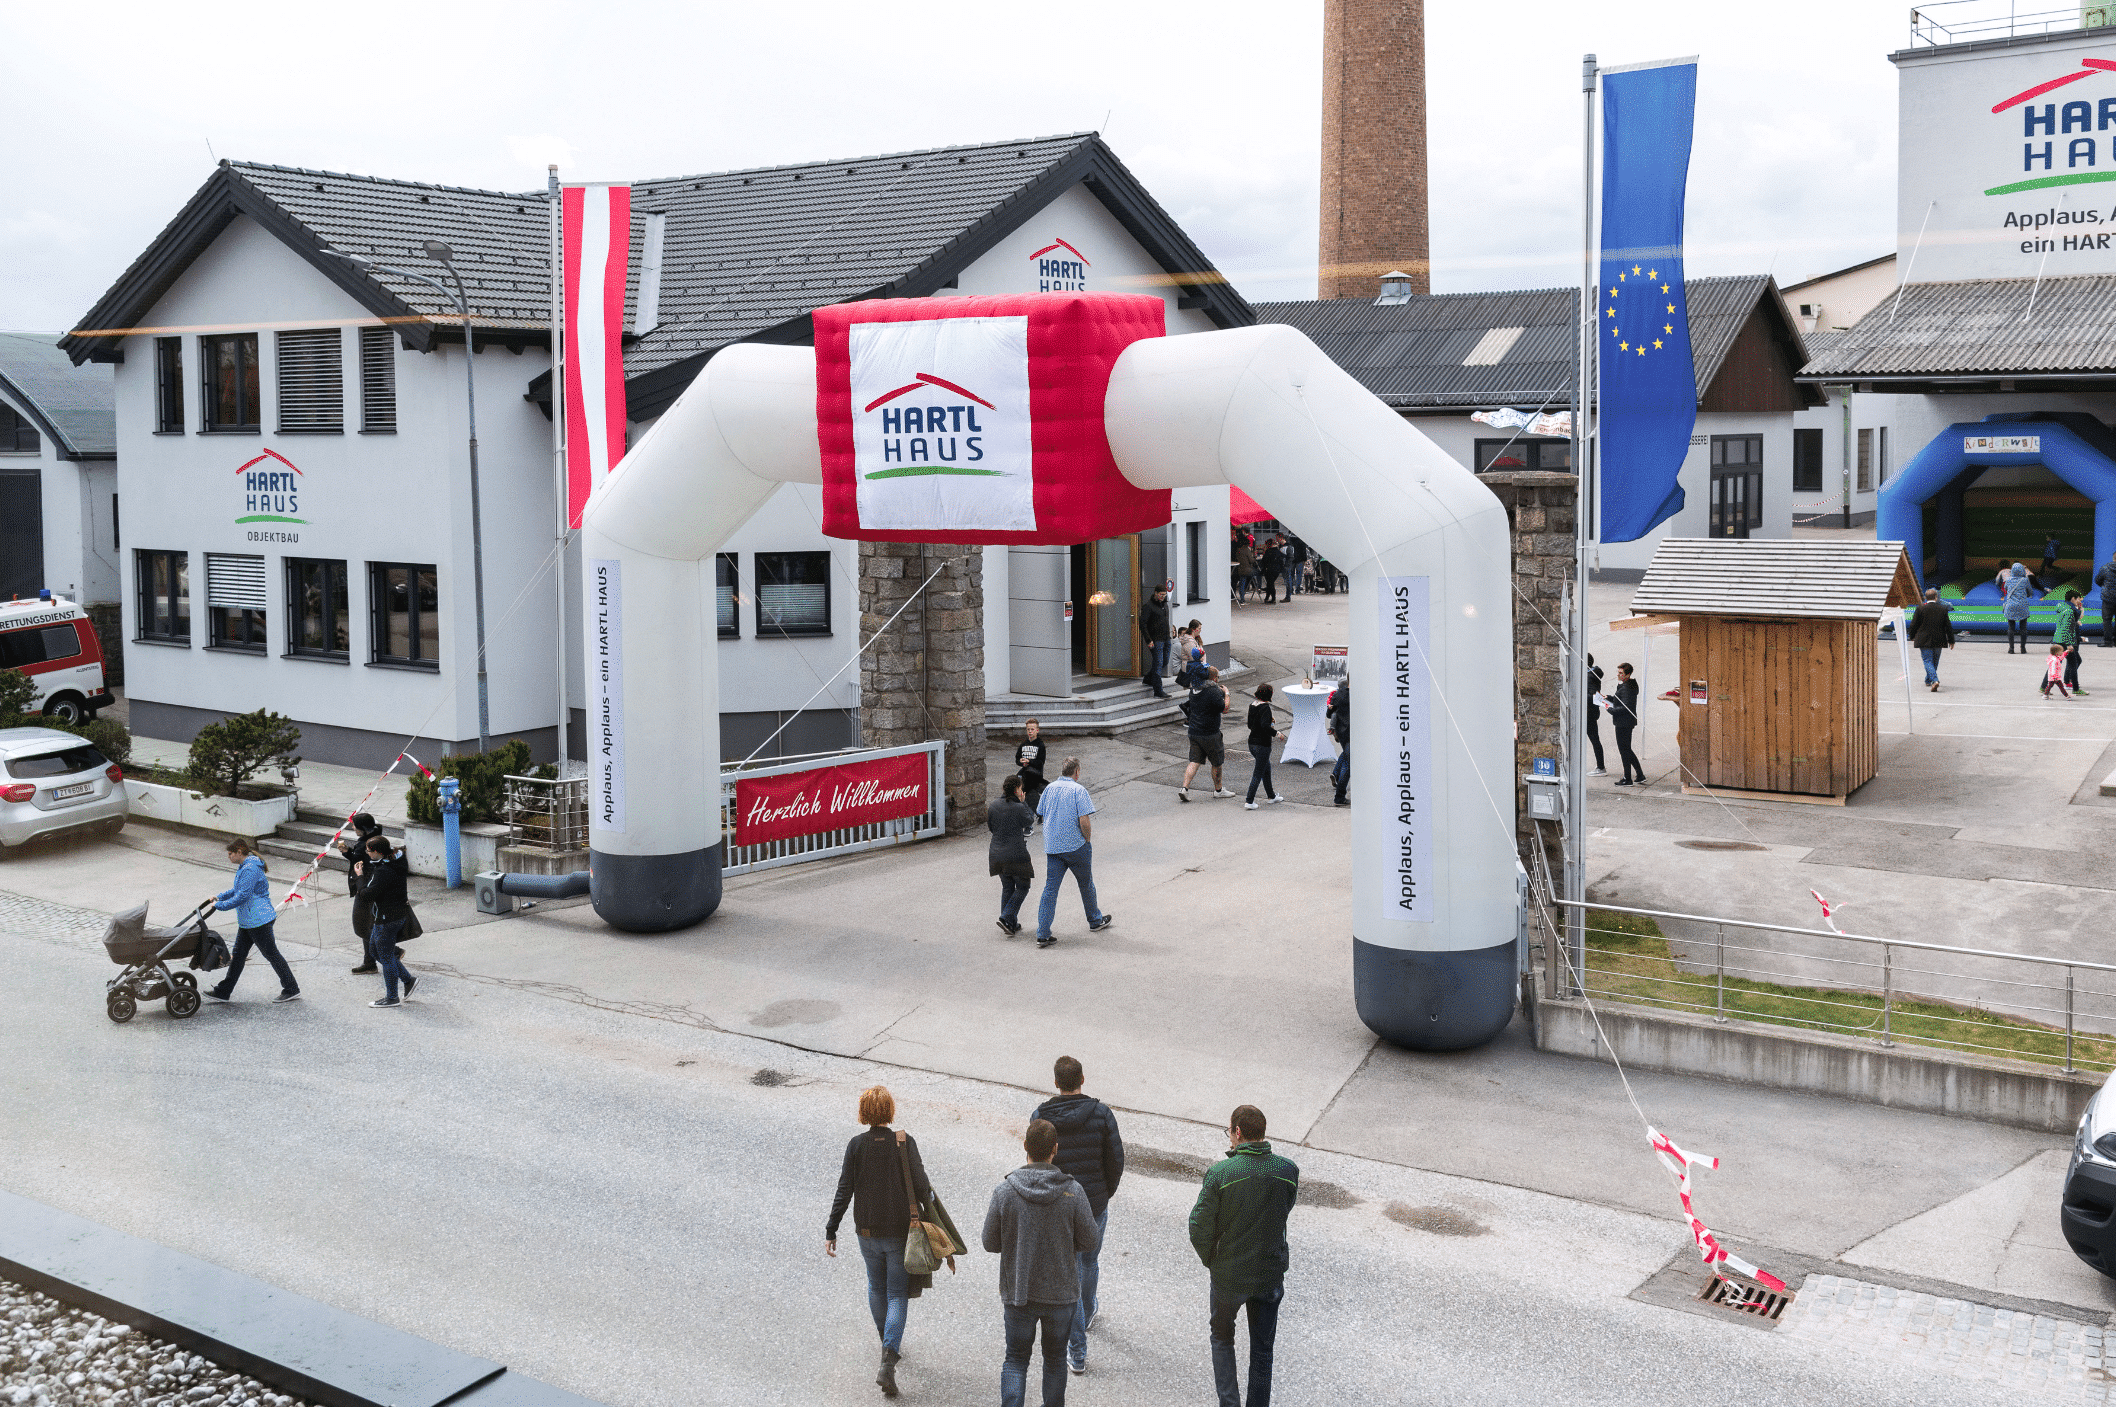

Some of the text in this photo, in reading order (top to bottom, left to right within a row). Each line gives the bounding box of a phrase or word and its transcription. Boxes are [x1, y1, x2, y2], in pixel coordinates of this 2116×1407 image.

[2024, 97, 2116, 138] HAR
[2024, 135, 2116, 172] HA
[2003, 208, 2105, 231] Applaus,
[2020, 233, 2116, 253] ein HAR
[1040, 259, 1085, 280] HARTL
[882, 405, 982, 434] HARTL
[884, 436, 984, 462] HAUS
[1690, 434, 1709, 445] SSEREI
[246, 472, 298, 492] HARTL
[246, 494, 298, 513] HAUS
[247, 531, 299, 543] OBJEKTBAU
[598, 566, 608, 606] HAUS
[0, 610, 75, 630] RETTUNGSDIENST
[1395, 586, 1409, 636] HAUS
[599, 609, 609, 655] HARTL
[600, 660, 609, 682] ein
[1396, 640, 1410, 698] HARTL
[601, 697, 613, 756] Applaus
[1396, 704, 1410, 732] ein
[603, 760, 615, 823] Applaus,
[1396, 750, 1415, 826] Applaus
[746, 779, 921, 827] Herzlich Willkommen
[1398, 830, 1416, 911] Applaus,
